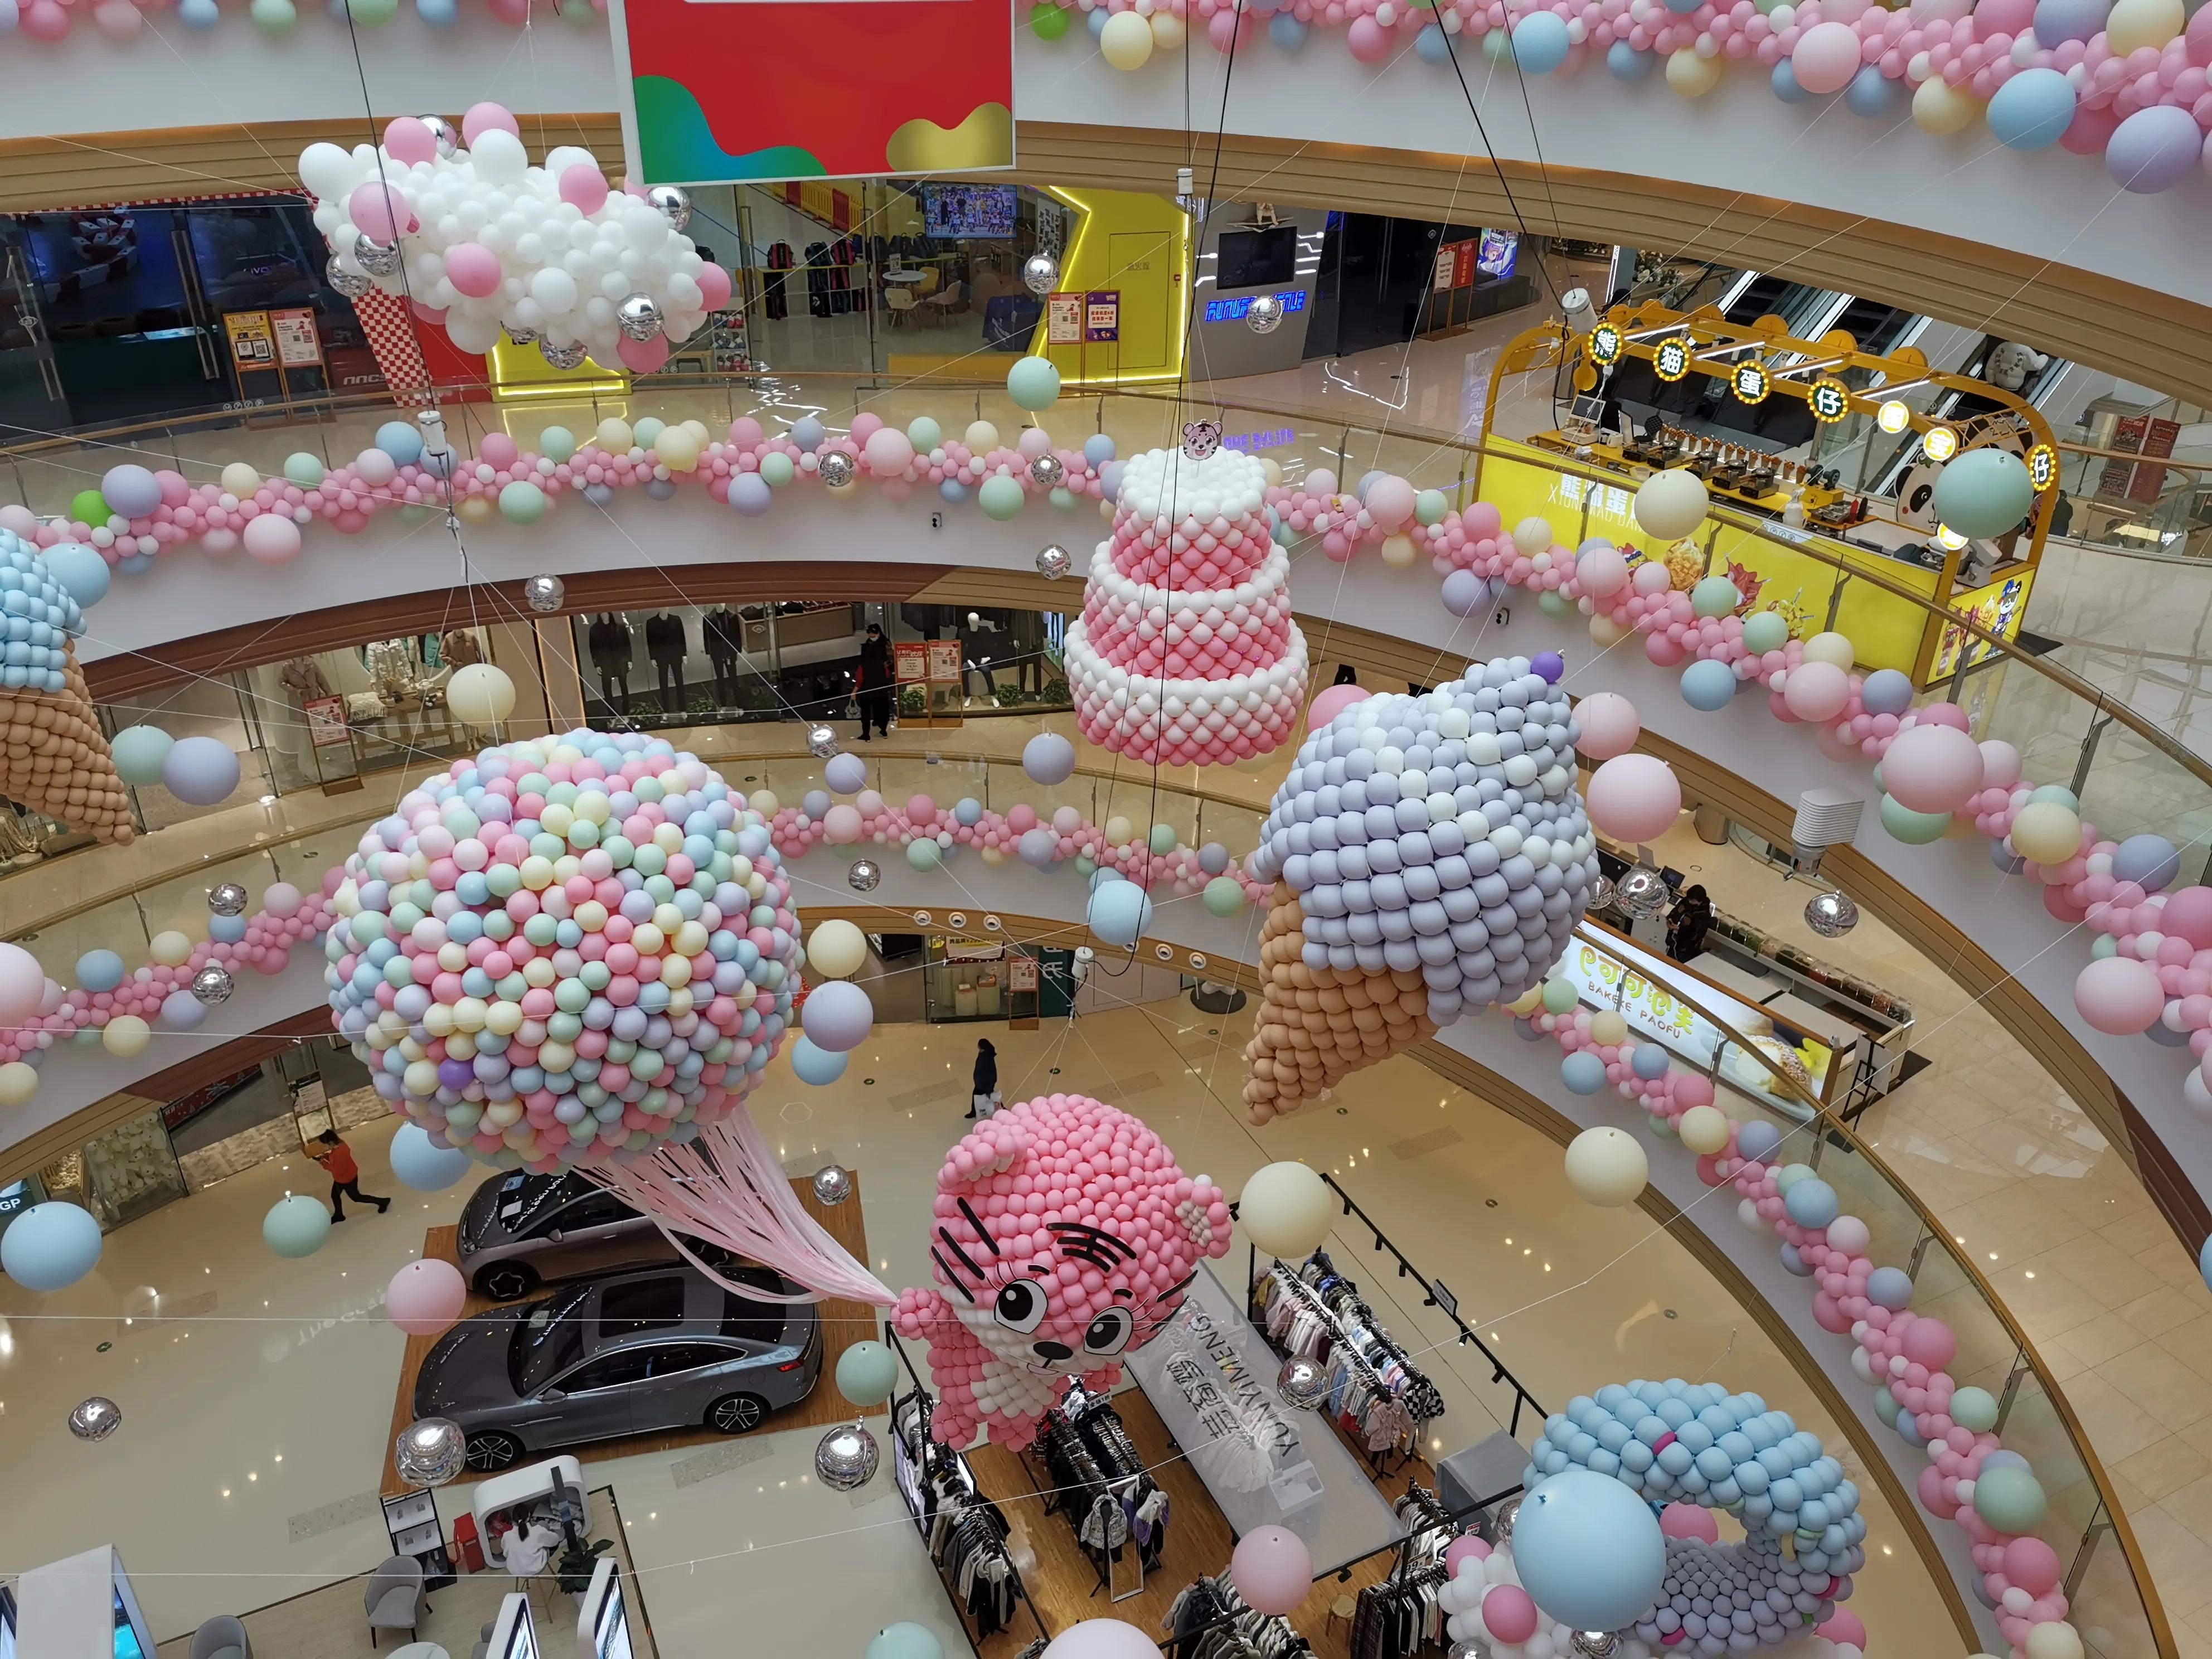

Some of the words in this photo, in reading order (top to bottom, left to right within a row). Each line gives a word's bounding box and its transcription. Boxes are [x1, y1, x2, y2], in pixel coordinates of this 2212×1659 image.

[1205, 296, 1257, 322] FUTUR
[2034, 454, 2050, 483] 仔
[1560, 473, 1636, 520] 熊猫蛋
[1588, 981, 1632, 1012] BAKEKE
[1640, 1010, 1681, 1039] PAOFU
[0, 1198, 21, 1211] GP
[1187, 1314, 1300, 1458] YUNYIMENG
